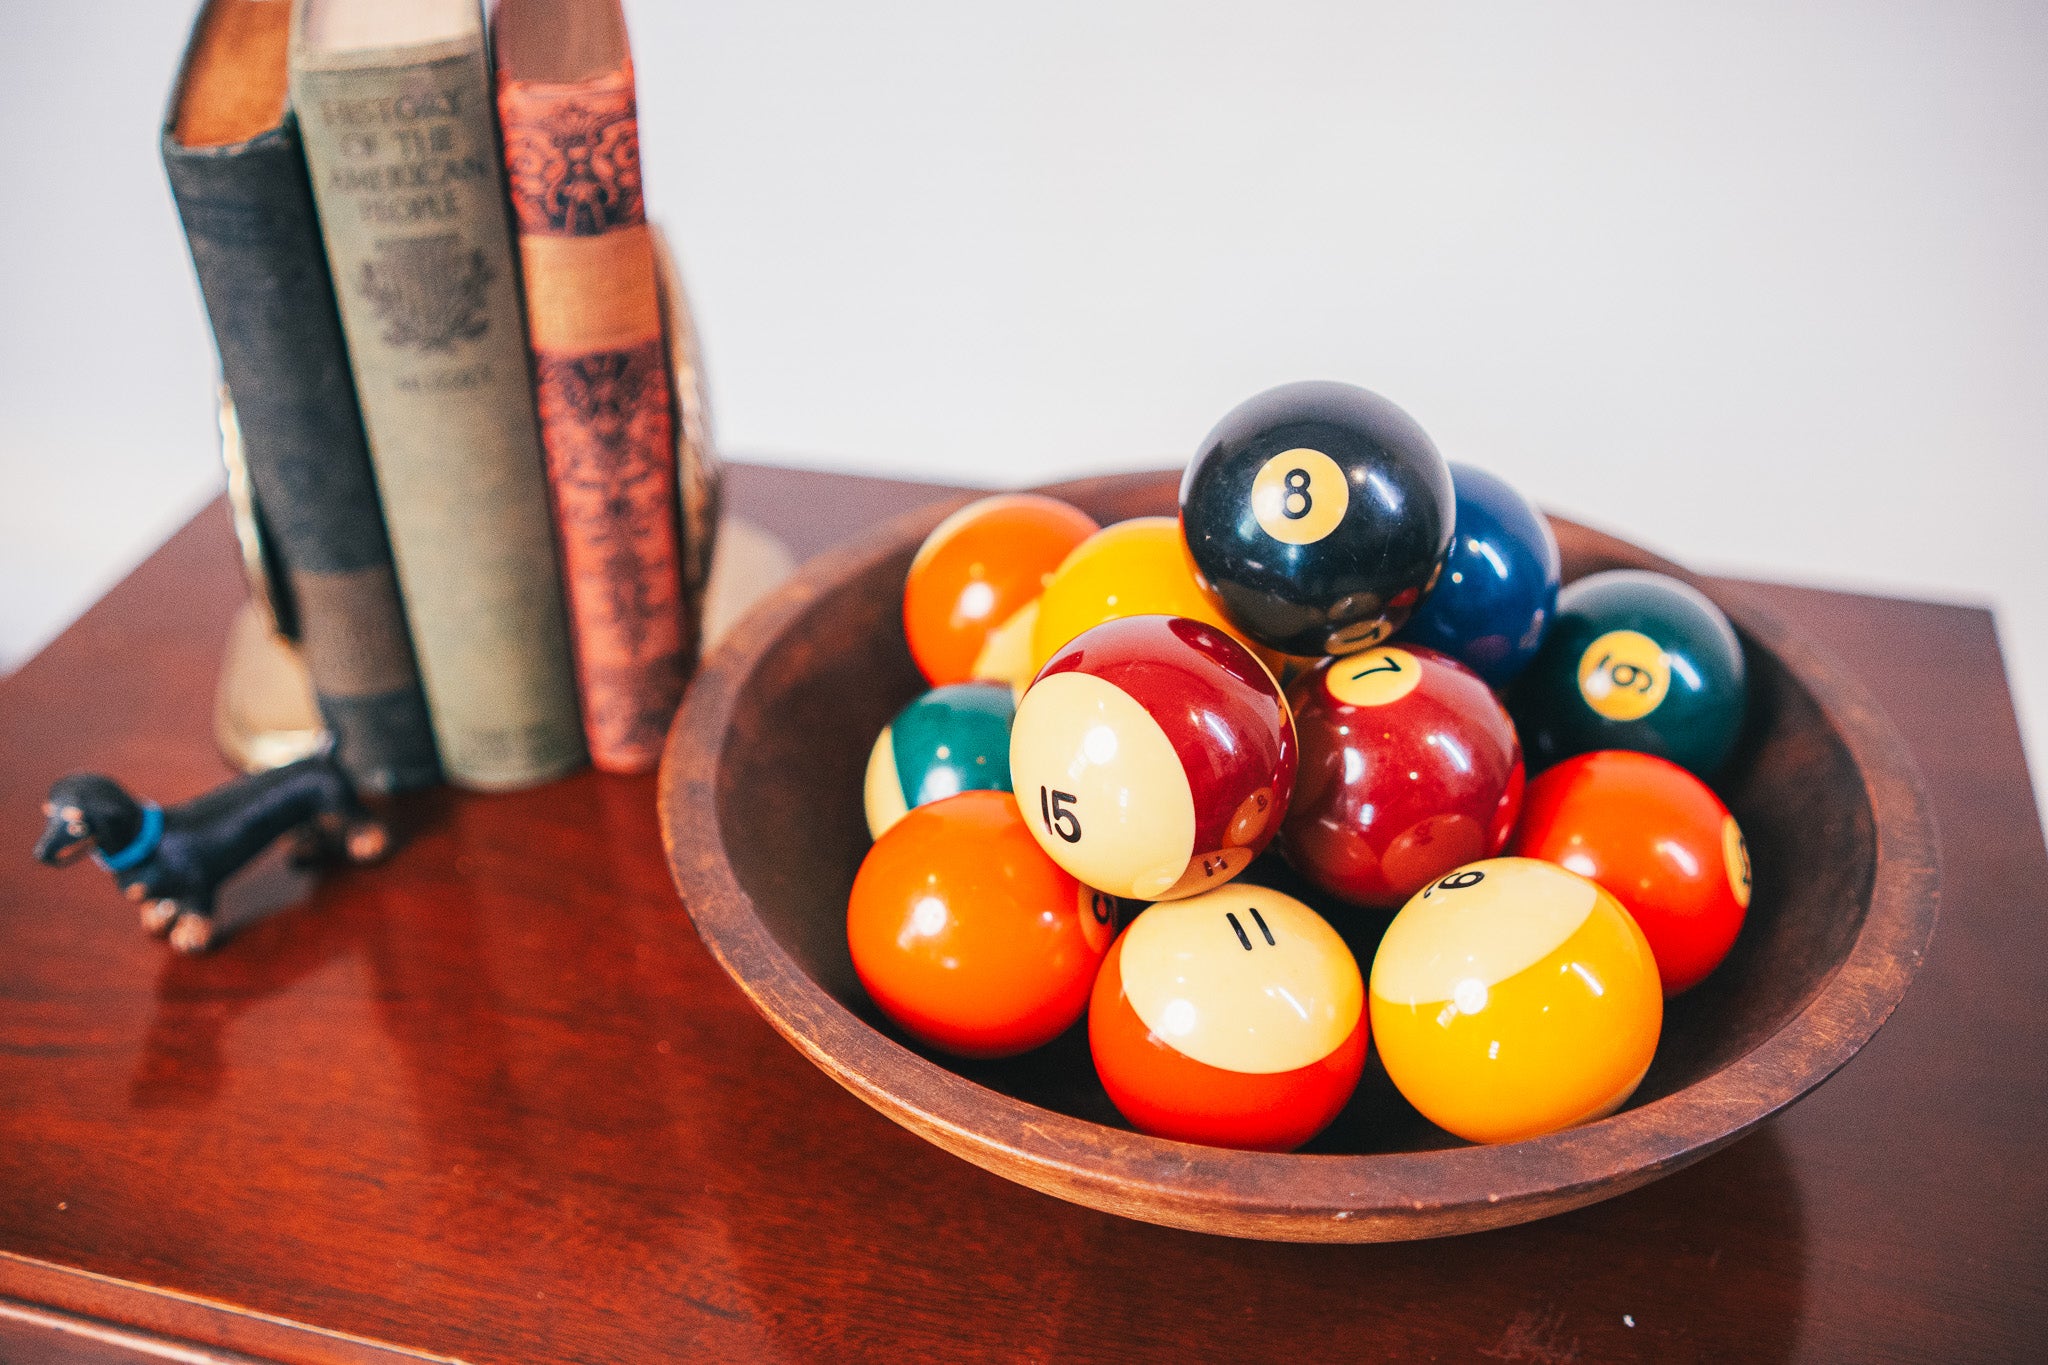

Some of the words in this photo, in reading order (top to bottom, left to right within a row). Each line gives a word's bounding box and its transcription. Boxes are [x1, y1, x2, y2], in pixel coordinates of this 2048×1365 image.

[1282, 468, 1312, 520] 8
[1352, 656, 1402, 680] 7
[1041, 785, 1082, 843] 15
[1225, 907, 1276, 951] 11
